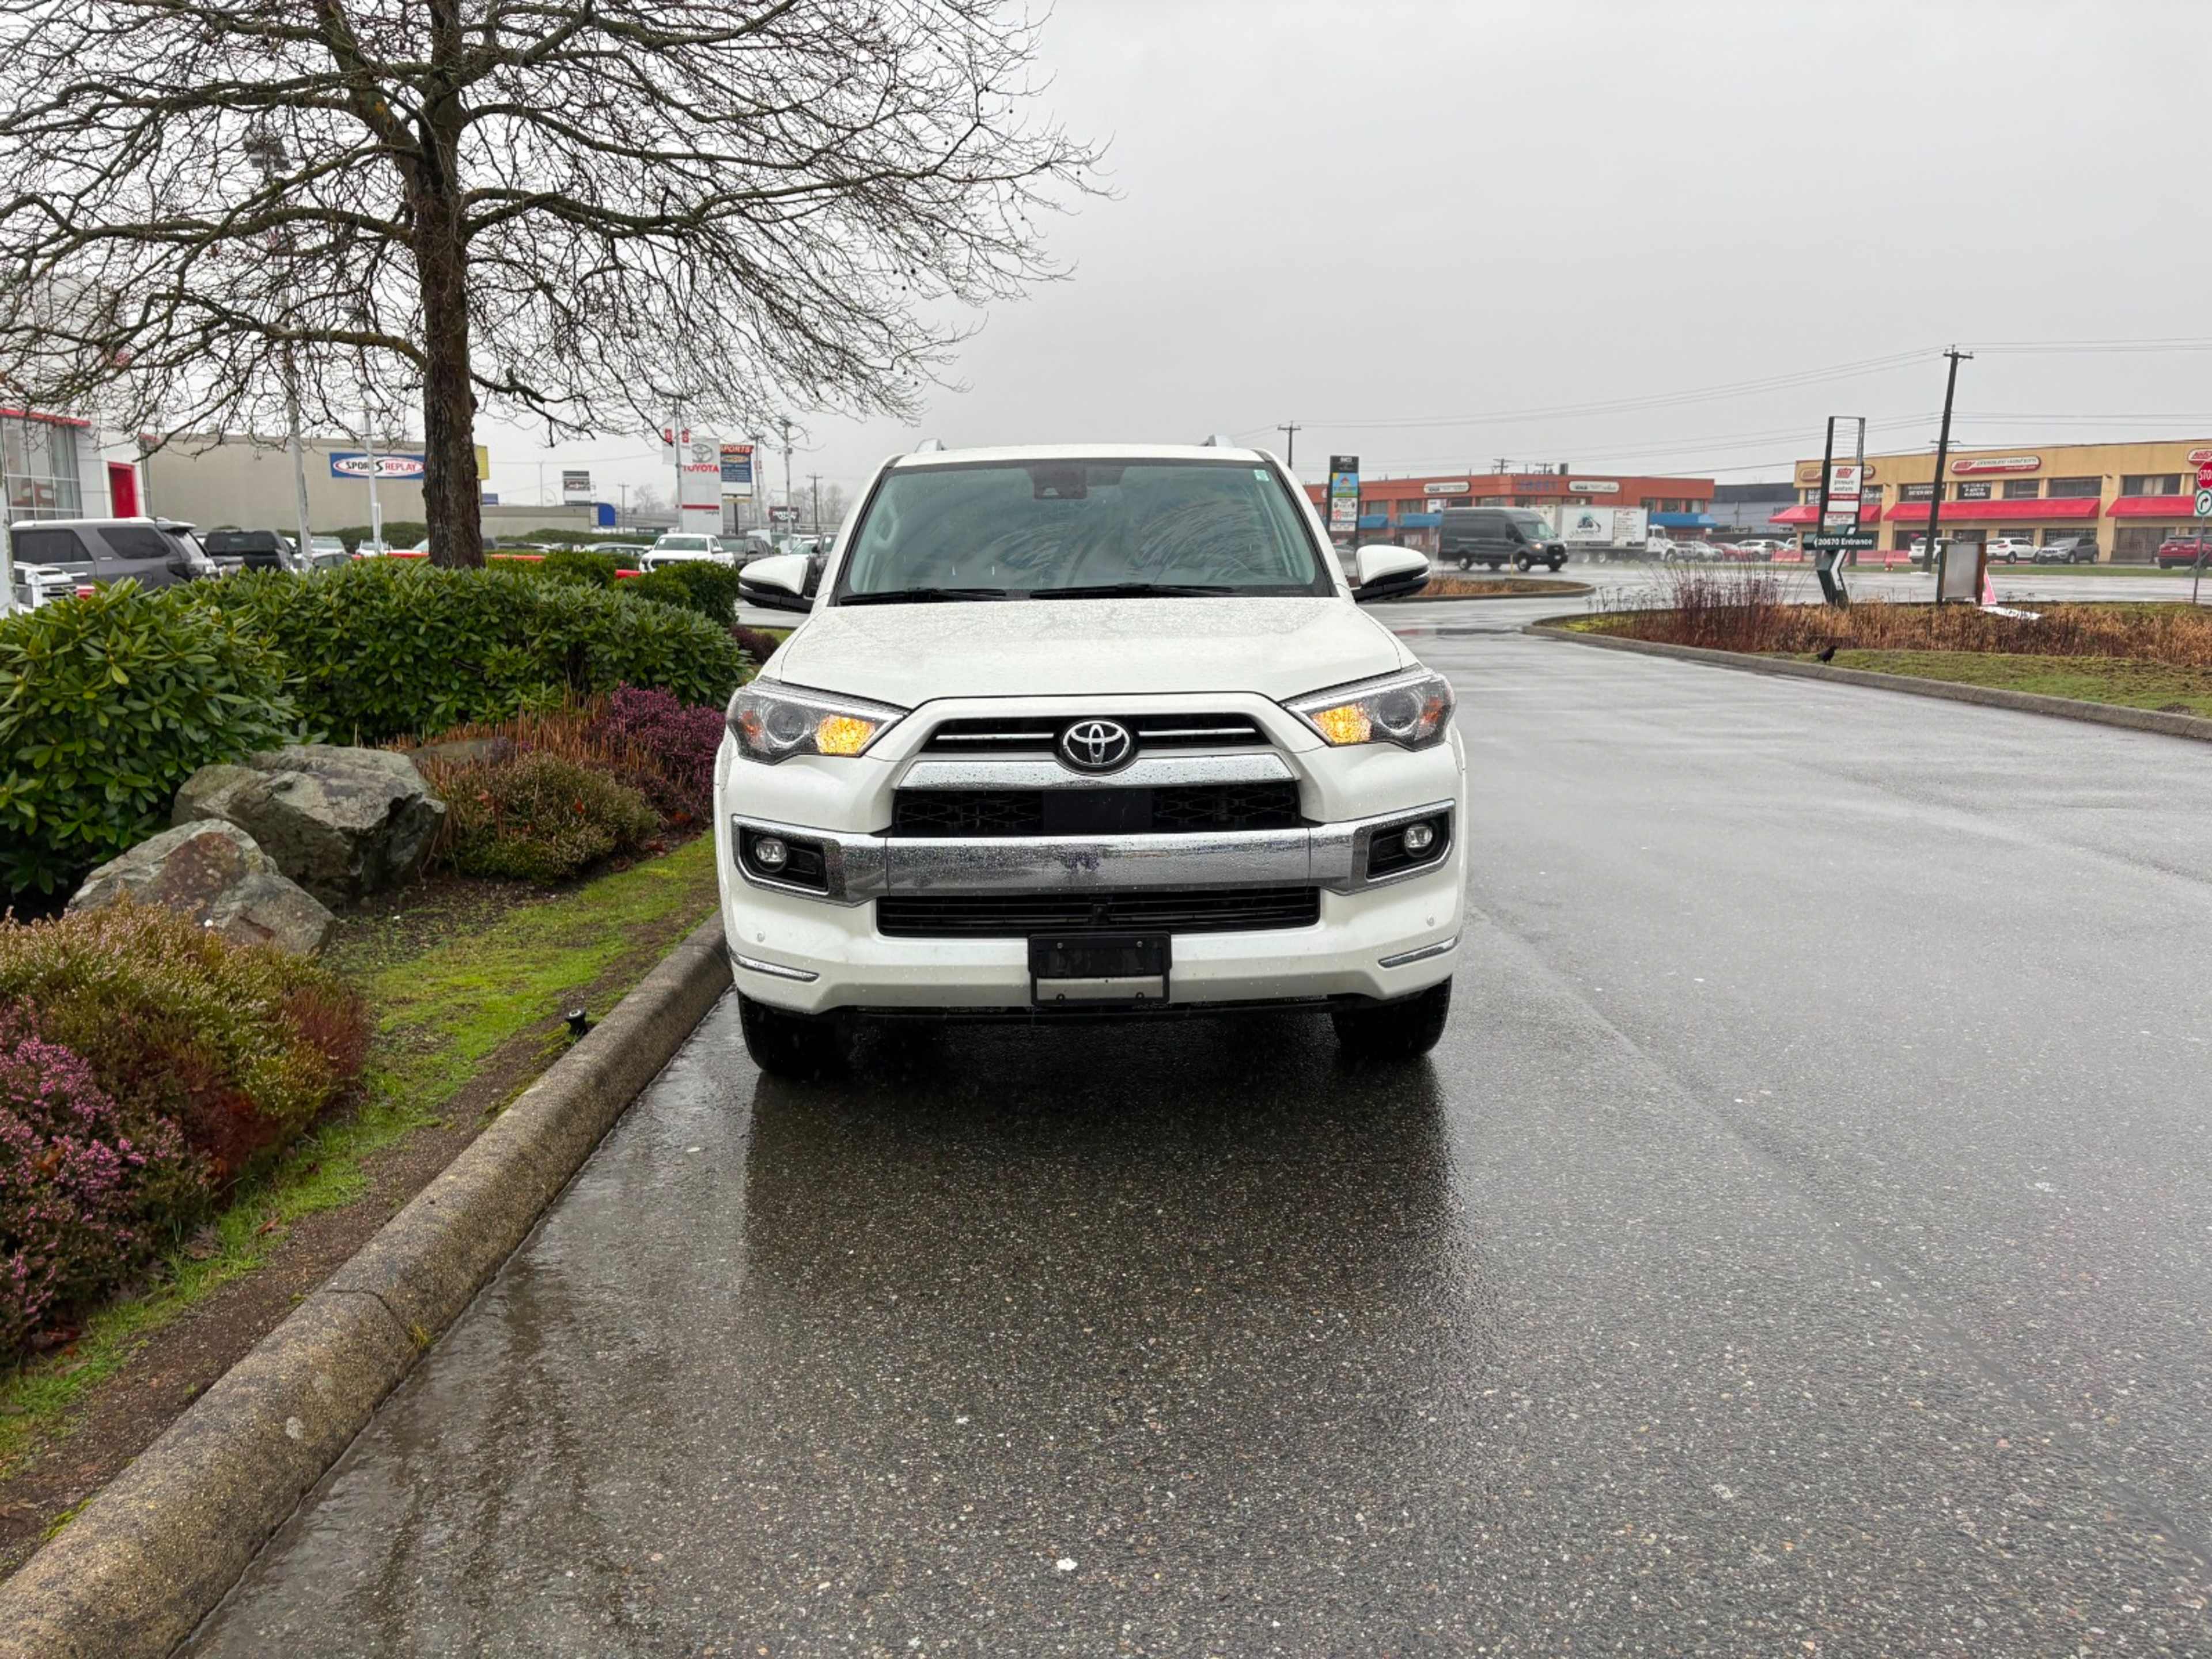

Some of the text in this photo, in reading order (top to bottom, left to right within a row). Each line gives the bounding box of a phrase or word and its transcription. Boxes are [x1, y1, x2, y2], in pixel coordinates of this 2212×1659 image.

[346, 460, 416, 471] SPORS REPLAY
[683, 464, 719, 473] TOYOTA
[2199, 469, 2212, 480] STO
[1841, 537, 1872, 546] Entrance
